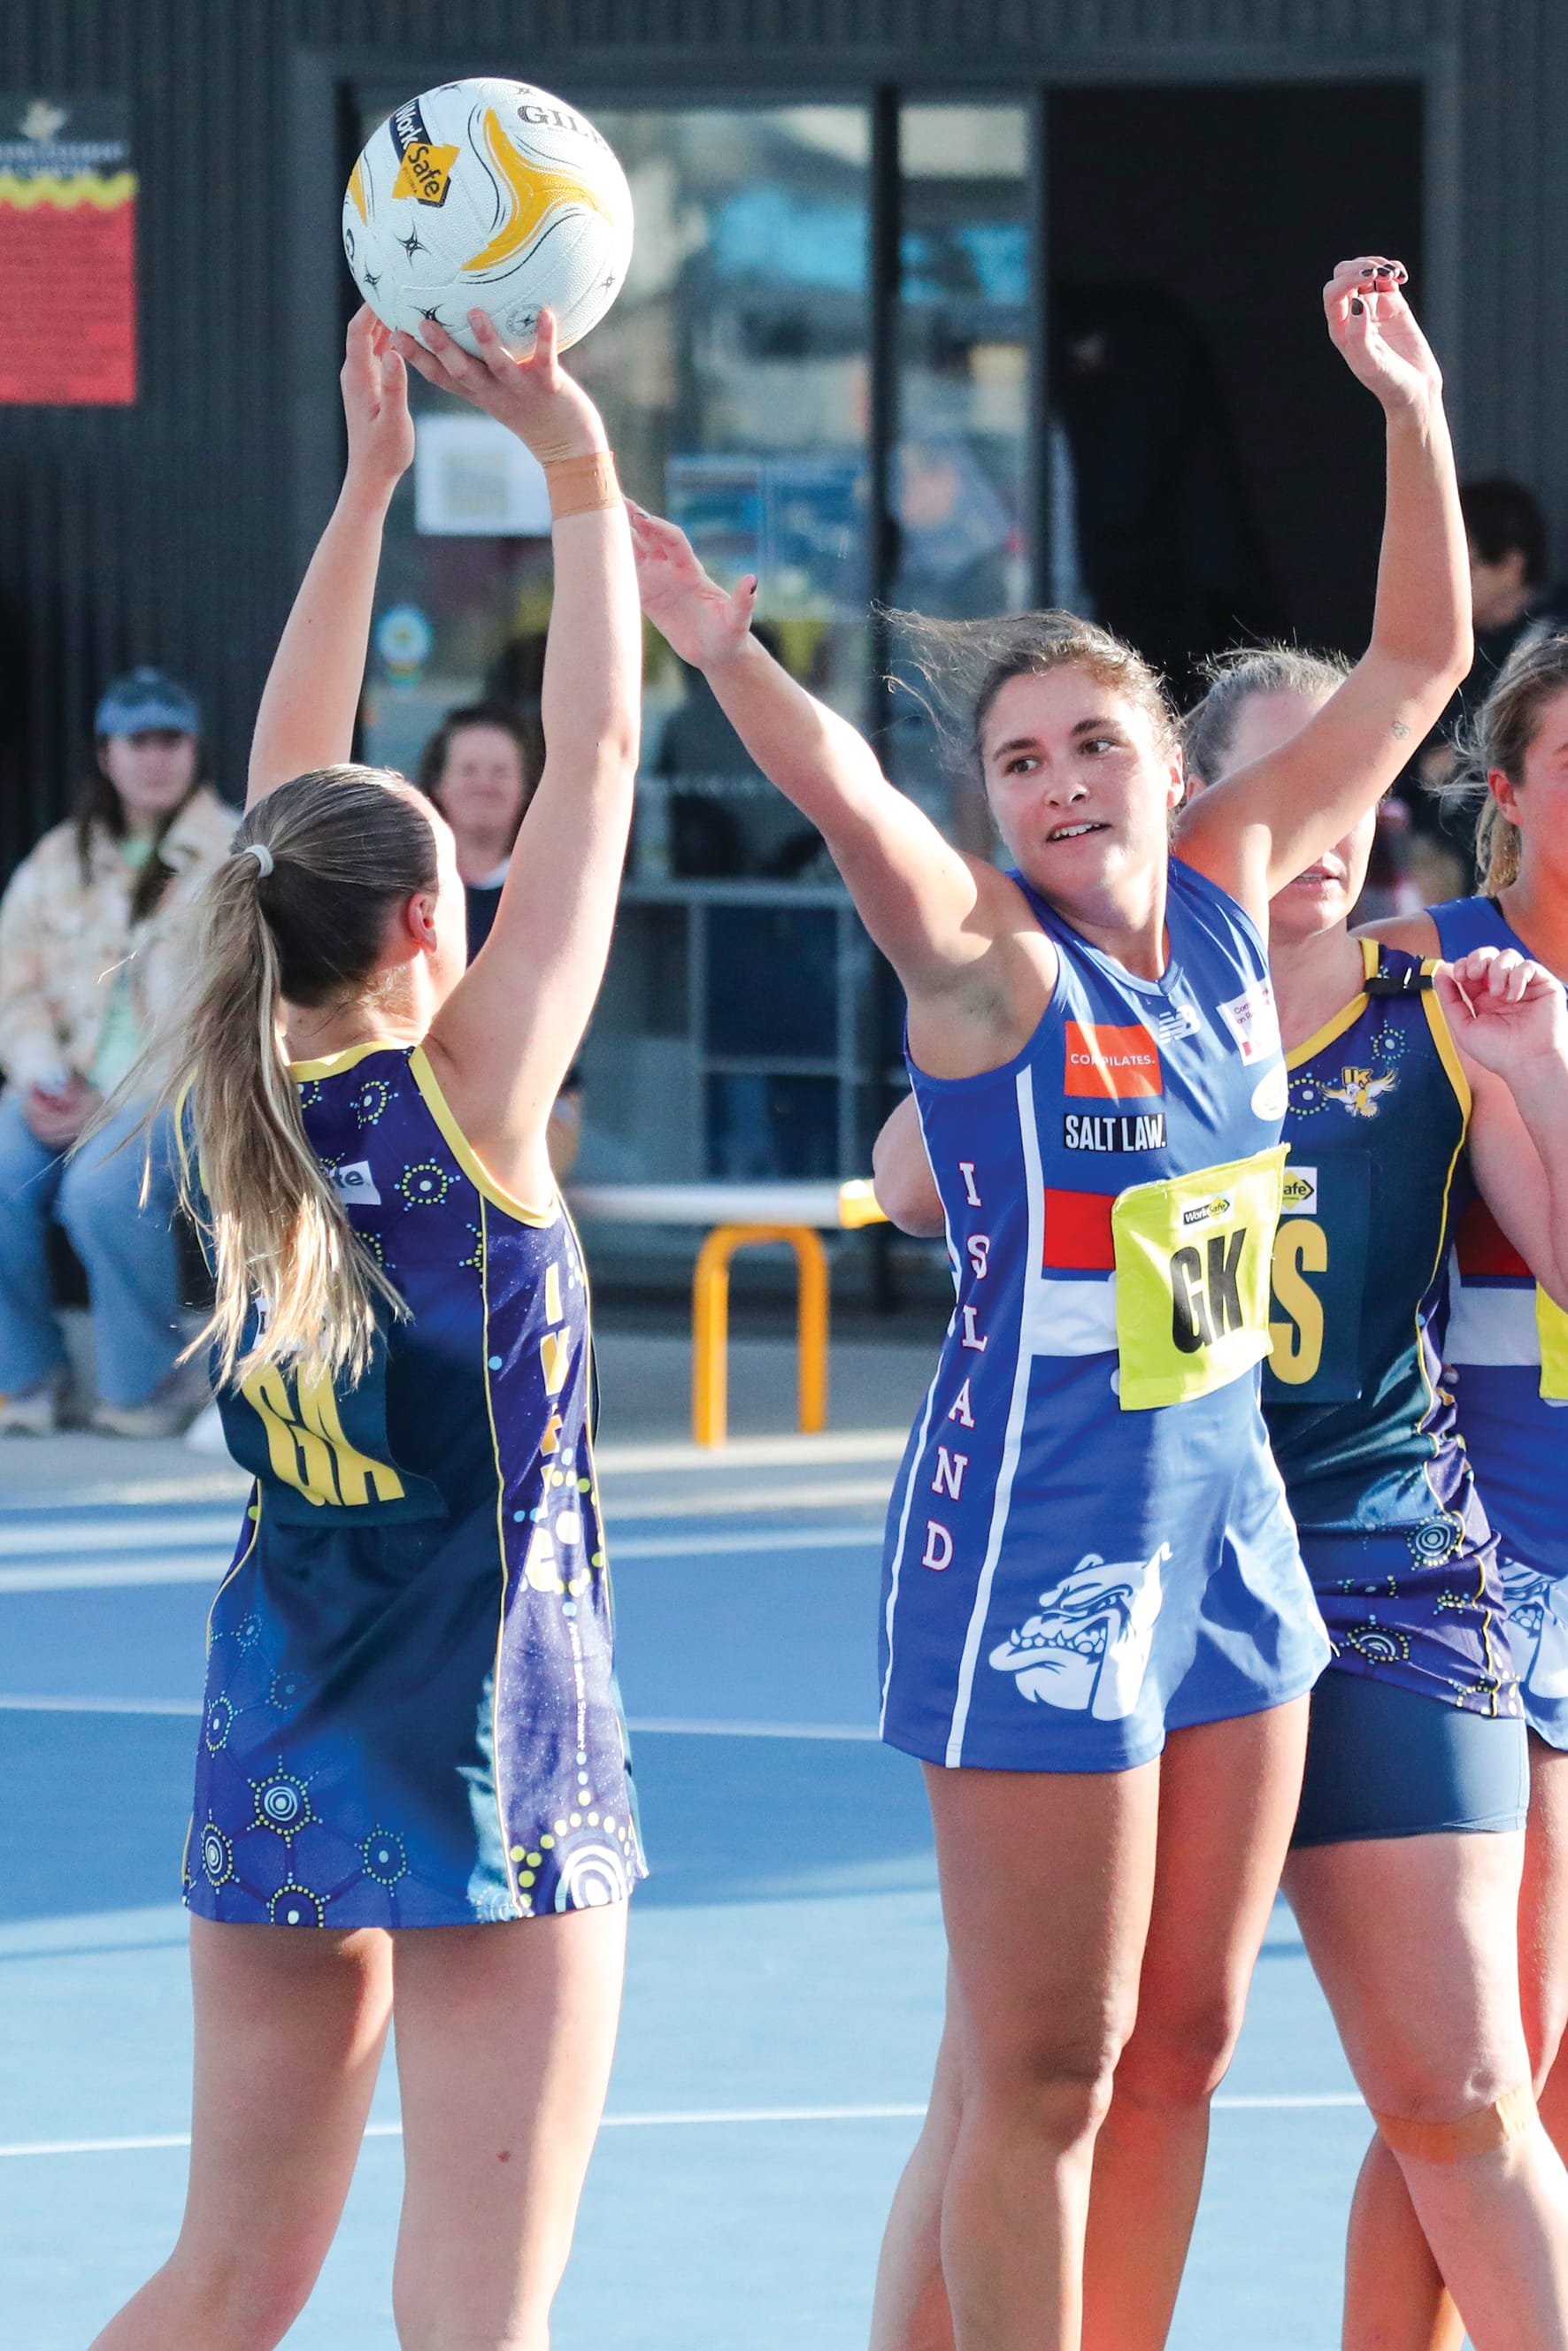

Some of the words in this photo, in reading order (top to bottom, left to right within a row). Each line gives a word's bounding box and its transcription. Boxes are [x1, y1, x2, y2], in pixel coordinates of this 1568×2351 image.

[1070, 1053, 1156, 1067] CORPILATES.
[1065, 1115, 1117, 1151] SALT
[1121, 1114, 1166, 1151] LAW.
[1283, 1181, 1307, 1196] afe
[1170, 1227, 1248, 1354] GK
[1269, 1218, 1328, 1386] S
[921, 1162, 991, 1571] ISLAND
[576, 1701, 587, 1751] Stewart
